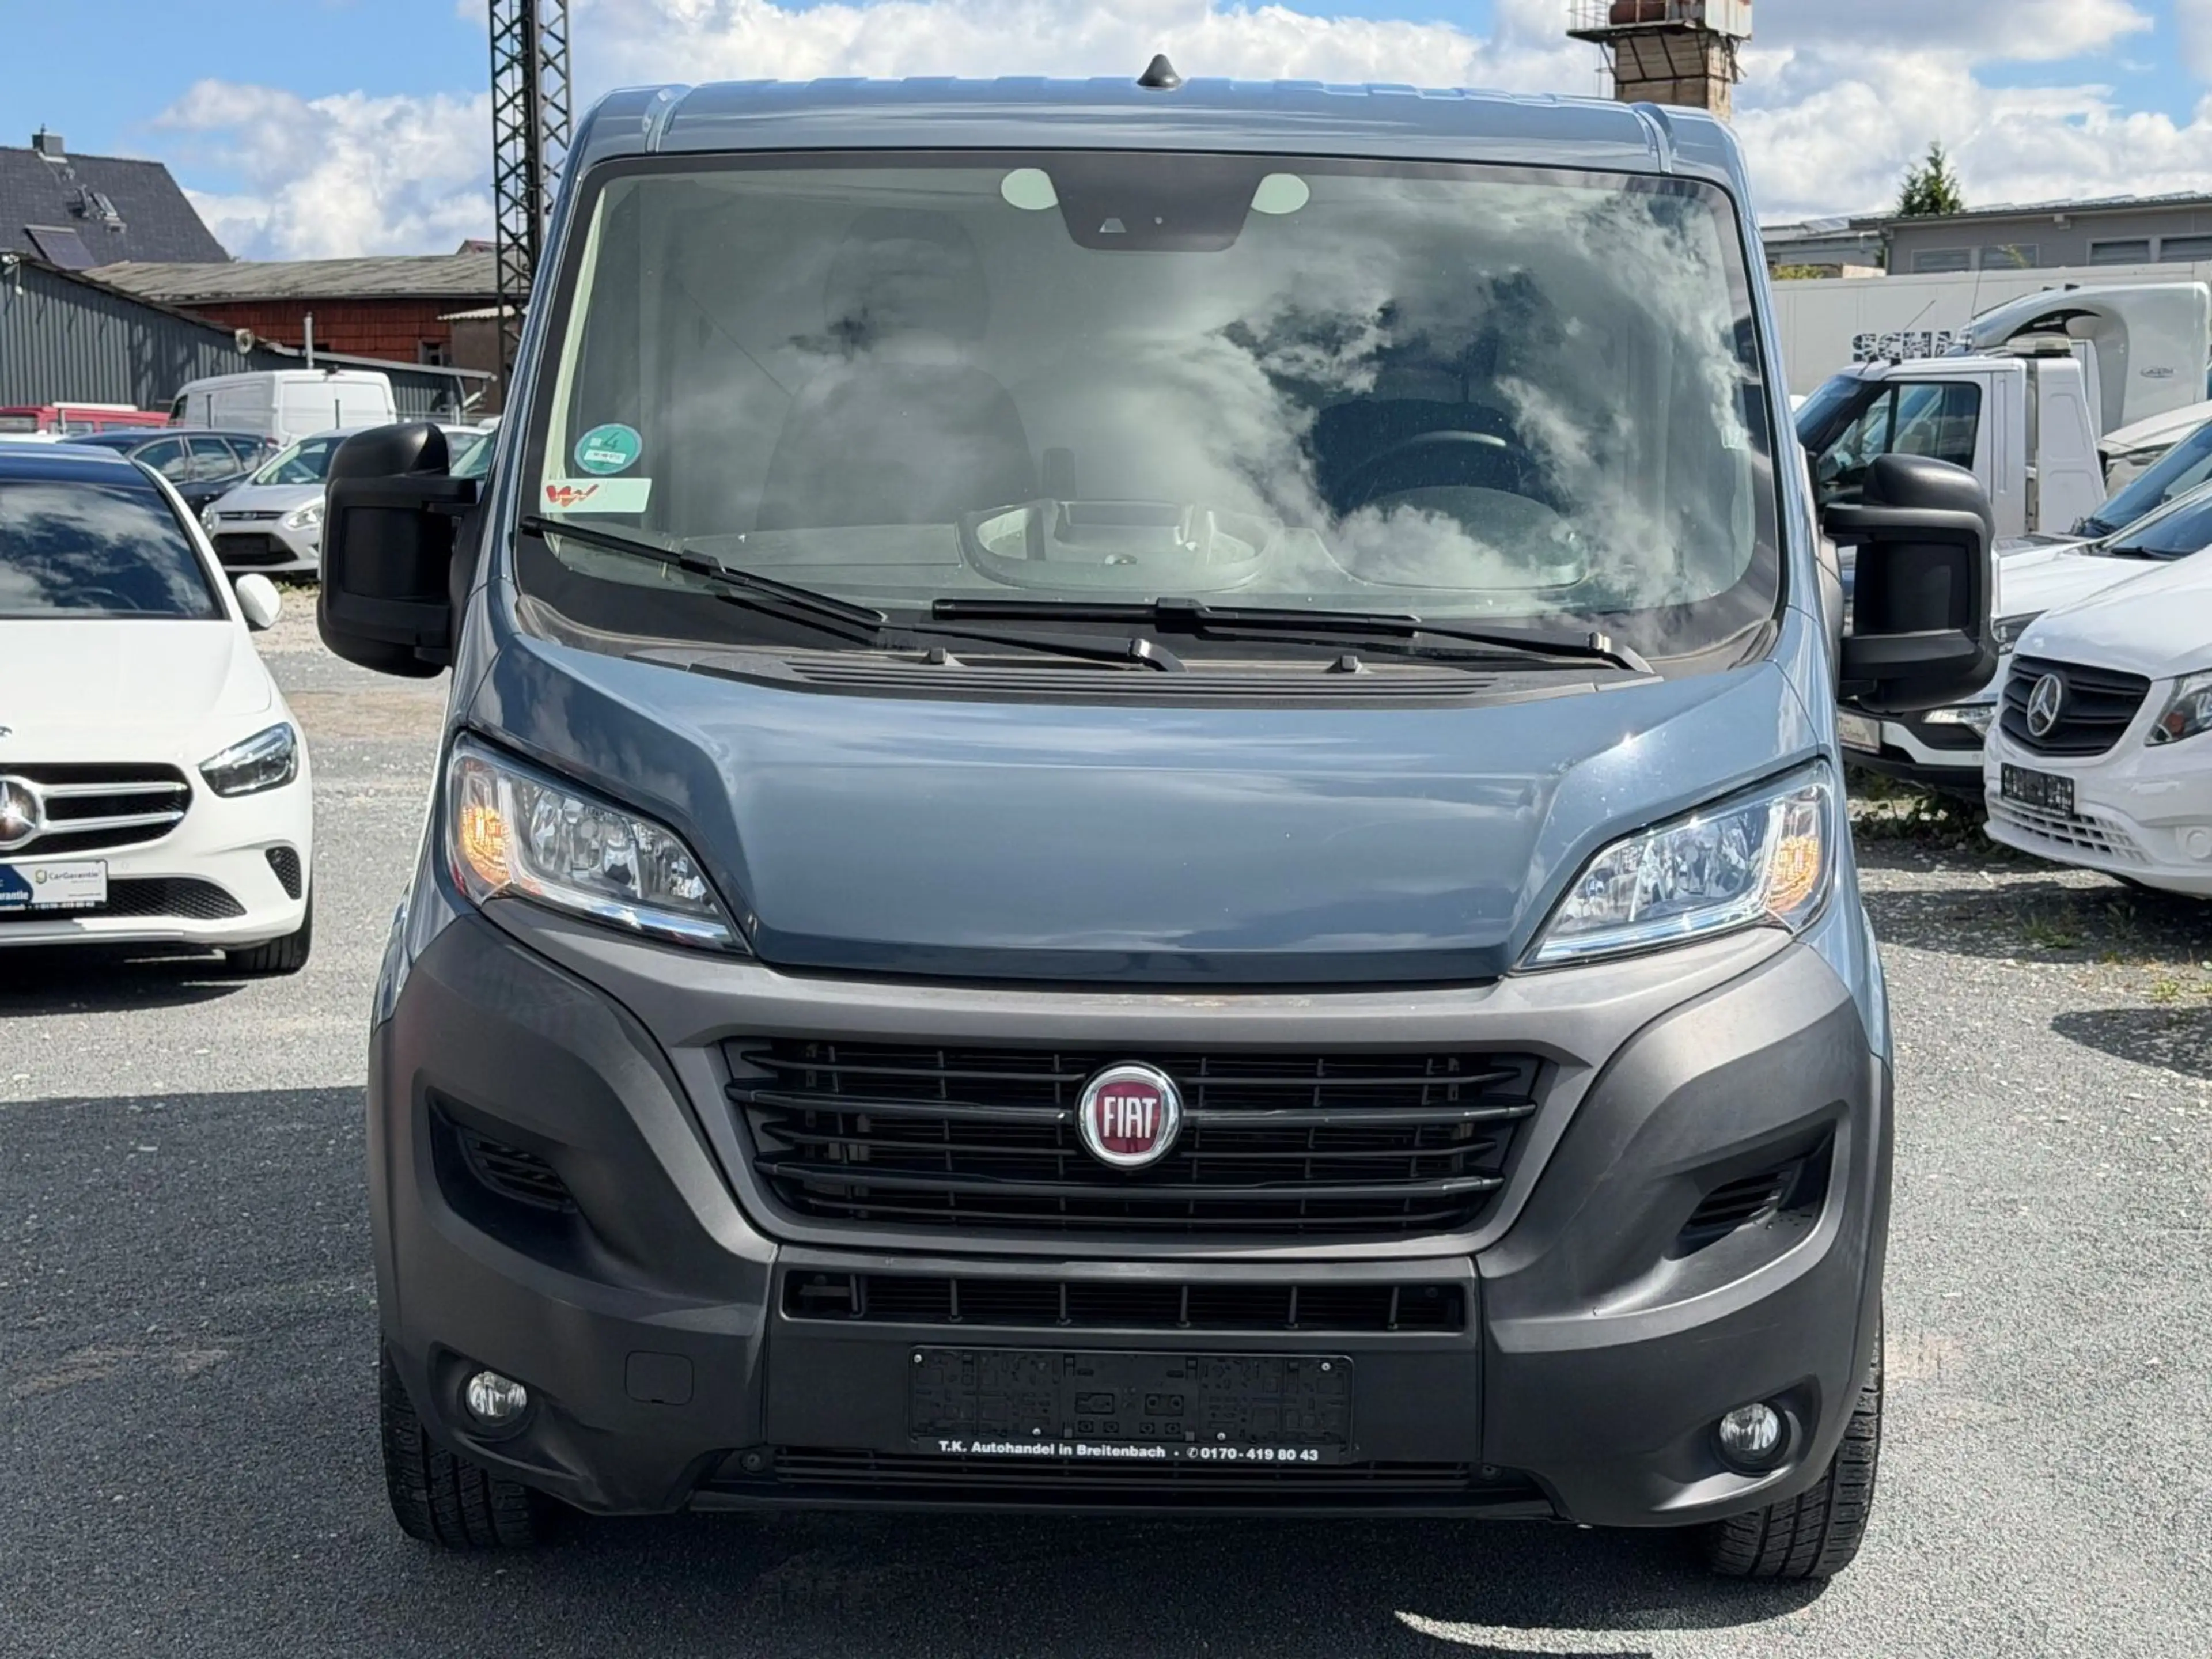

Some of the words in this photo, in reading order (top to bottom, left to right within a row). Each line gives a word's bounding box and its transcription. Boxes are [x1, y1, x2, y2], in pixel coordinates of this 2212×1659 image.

[603, 431, 619, 449] 4
[1103, 1096, 1157, 1138] FIAT
[938, 1440, 967, 1452] T.K.
[971, 1441, 1055, 1455] Autohandel
[1059, 1443, 1073, 1455] in
[1076, 1444, 1166, 1458] Breitenbach
[1277, 1449, 1297, 1461] 80
[1299, 1449, 1319, 1461] 43
